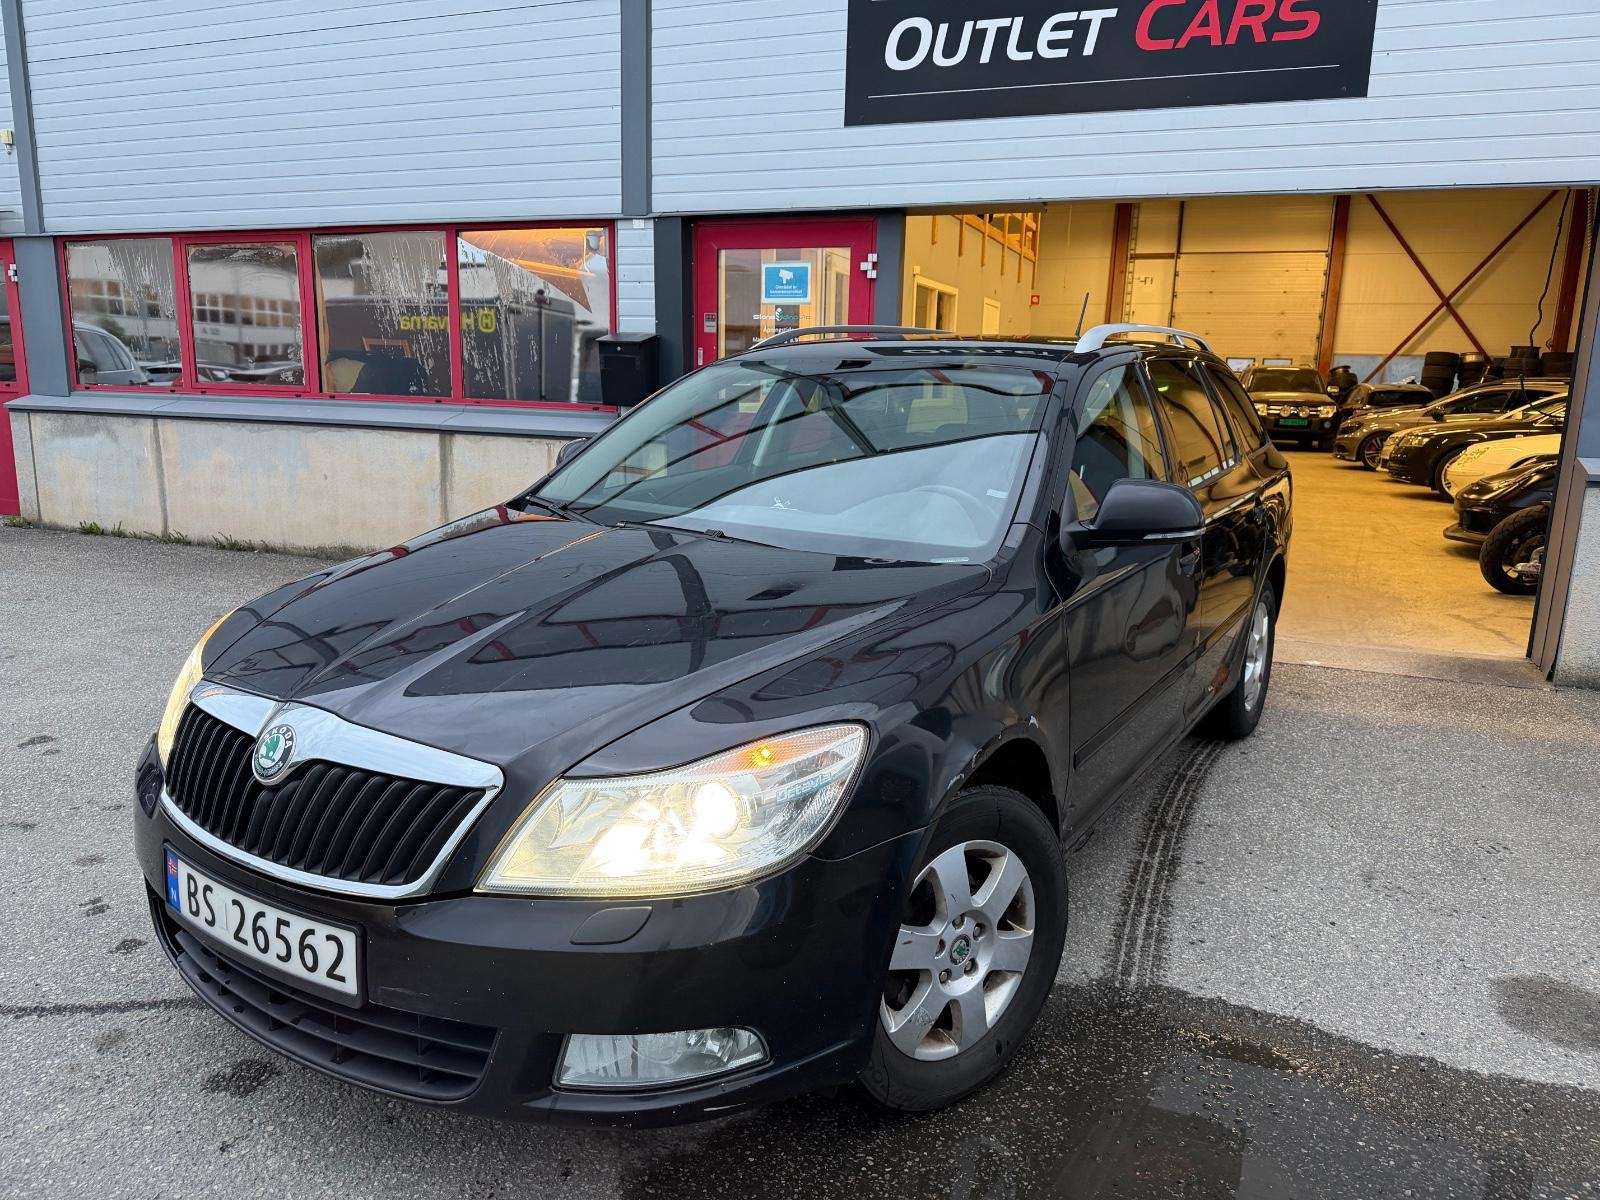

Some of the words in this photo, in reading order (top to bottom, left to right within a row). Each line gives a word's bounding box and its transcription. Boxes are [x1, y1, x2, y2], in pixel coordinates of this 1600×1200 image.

[884, 8, 1118, 71] OUTLET
[1135, 0, 1321, 51] CARS
[187, 872, 216, 928] BS
[231, 898, 347, 984] 26562
